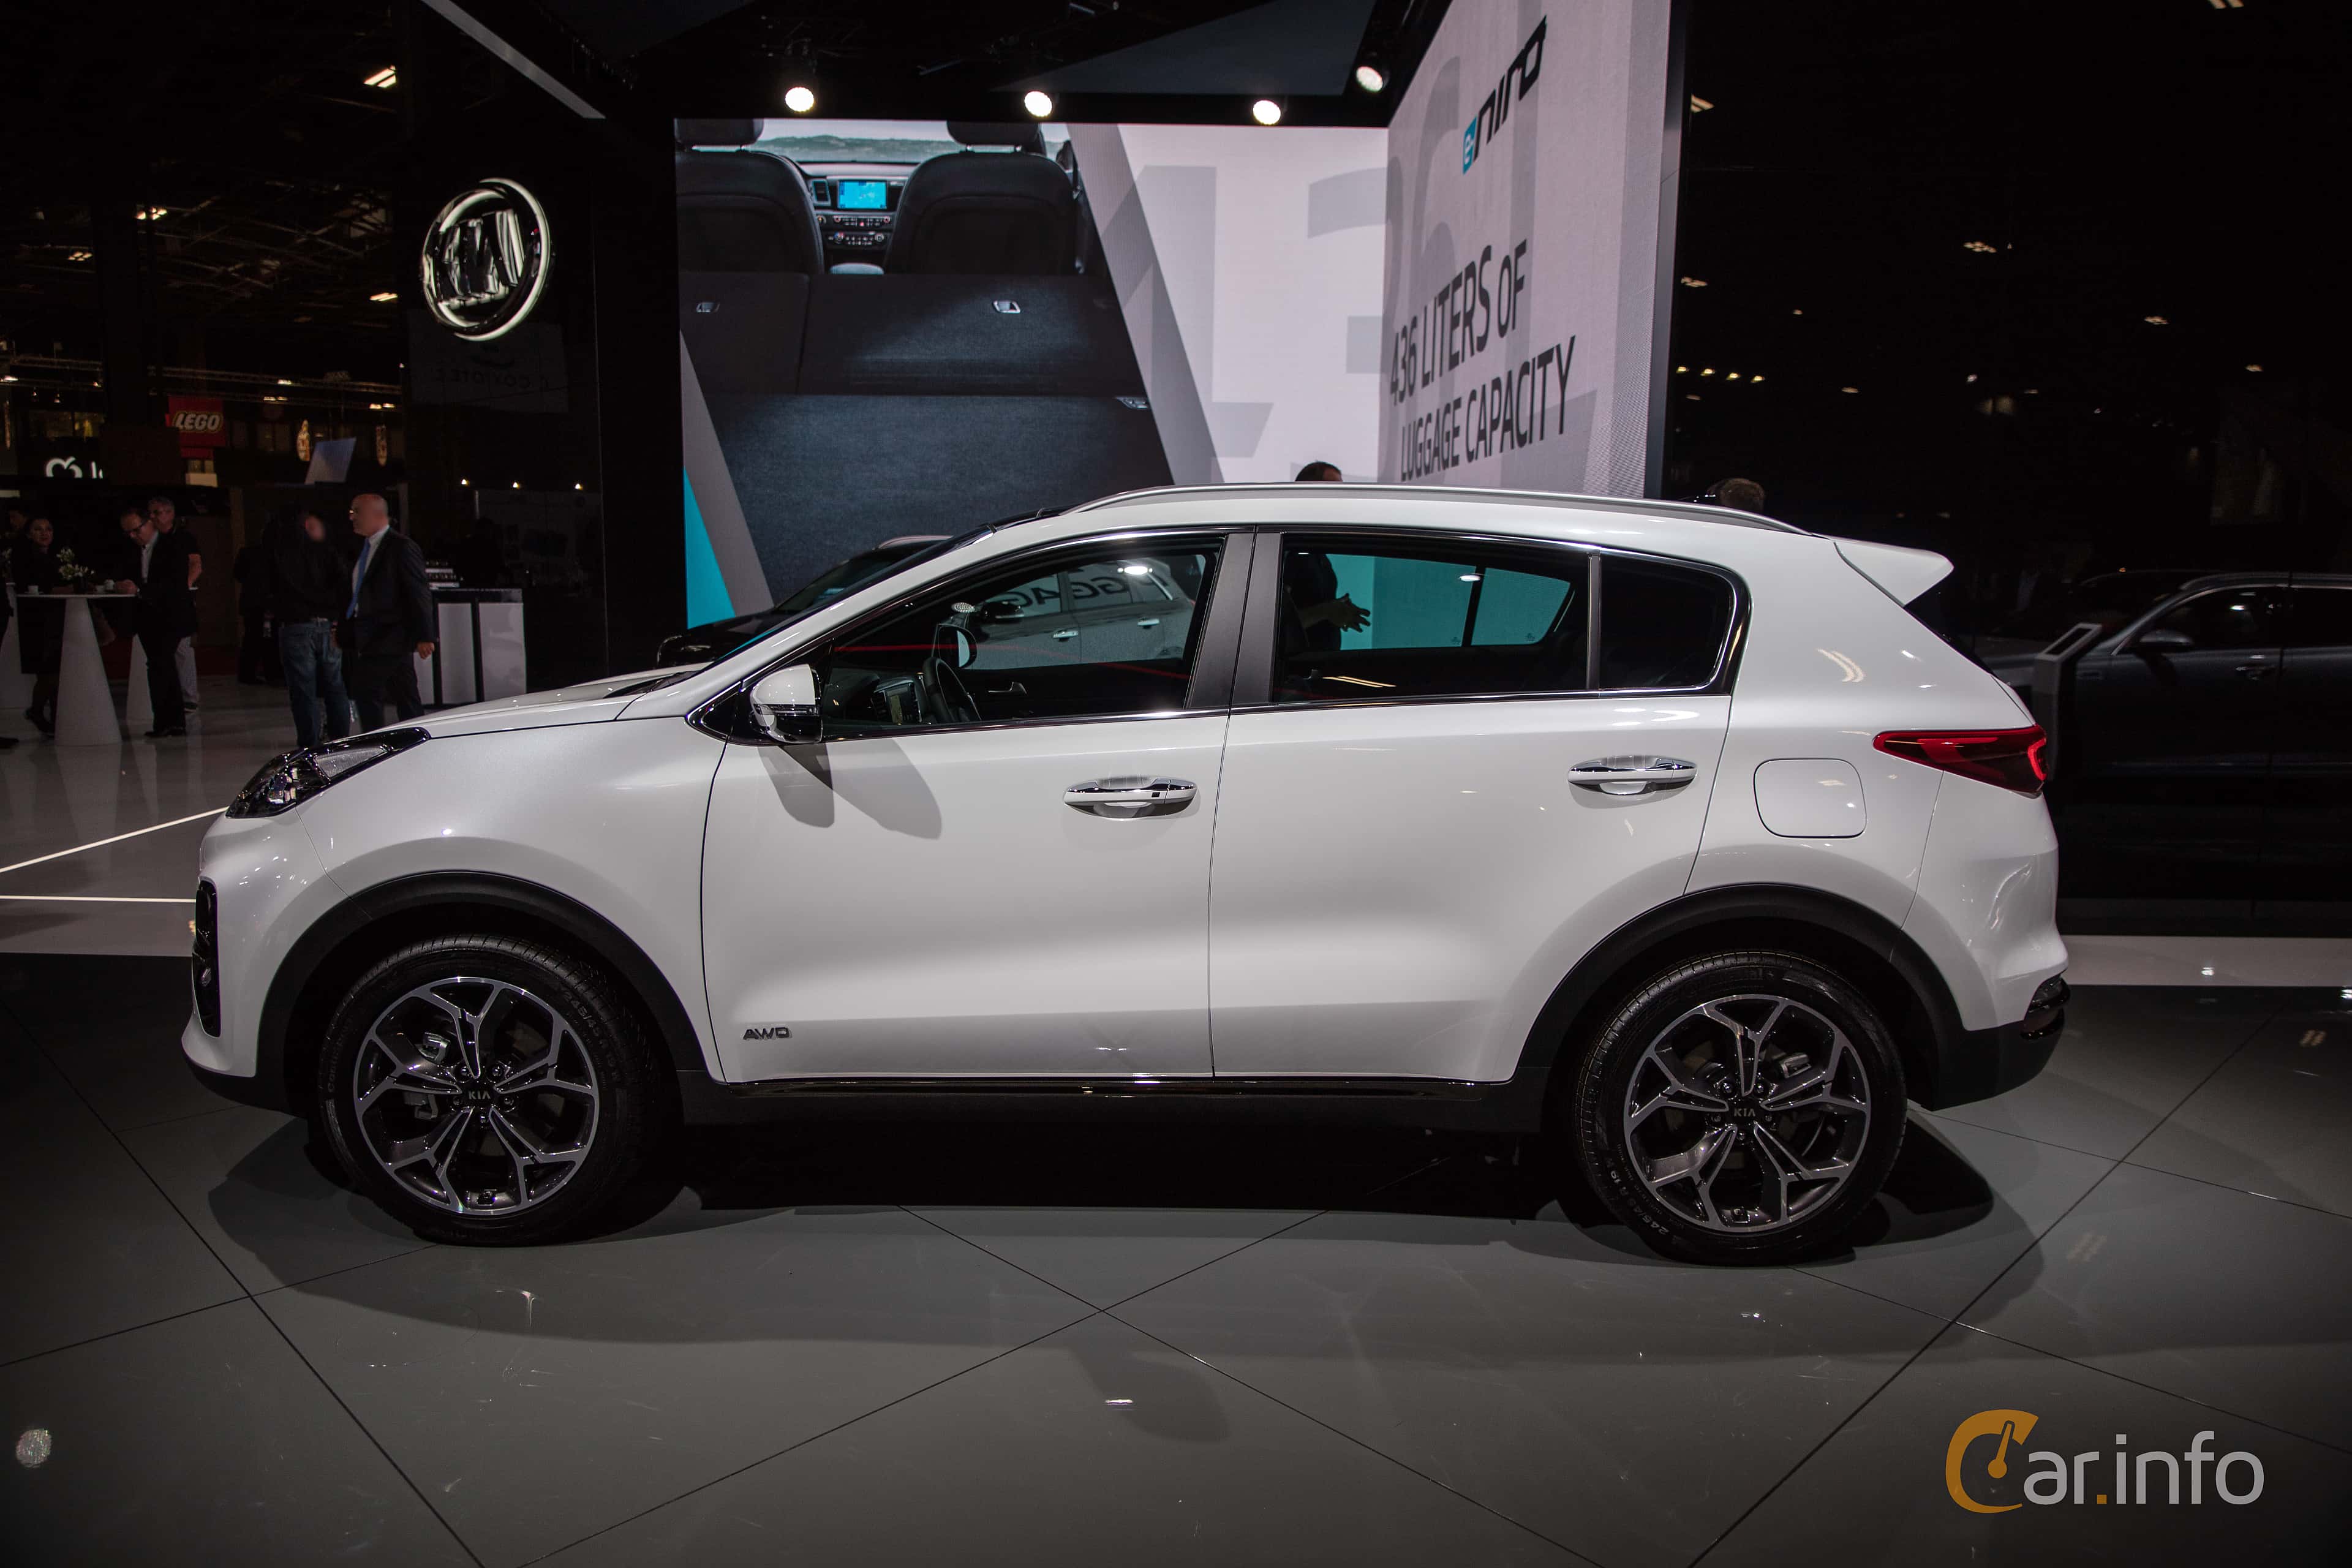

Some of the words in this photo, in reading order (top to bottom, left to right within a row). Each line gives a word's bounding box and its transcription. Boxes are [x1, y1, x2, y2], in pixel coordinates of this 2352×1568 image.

[1390, 315, 1417, 406] 436
[1422, 245, 1491, 389] LITERS
[1498, 239, 1527, 338] OF
[1401, 397, 1461, 482] LUGGAGE
[1466, 335, 1576, 462] CAPACITY
[174, 412, 222, 431] LEGO
[742, 1027, 792, 1040] AWD
[468, 1090, 491, 1100] KIA
[1733, 1107, 1756, 1117] KIA
